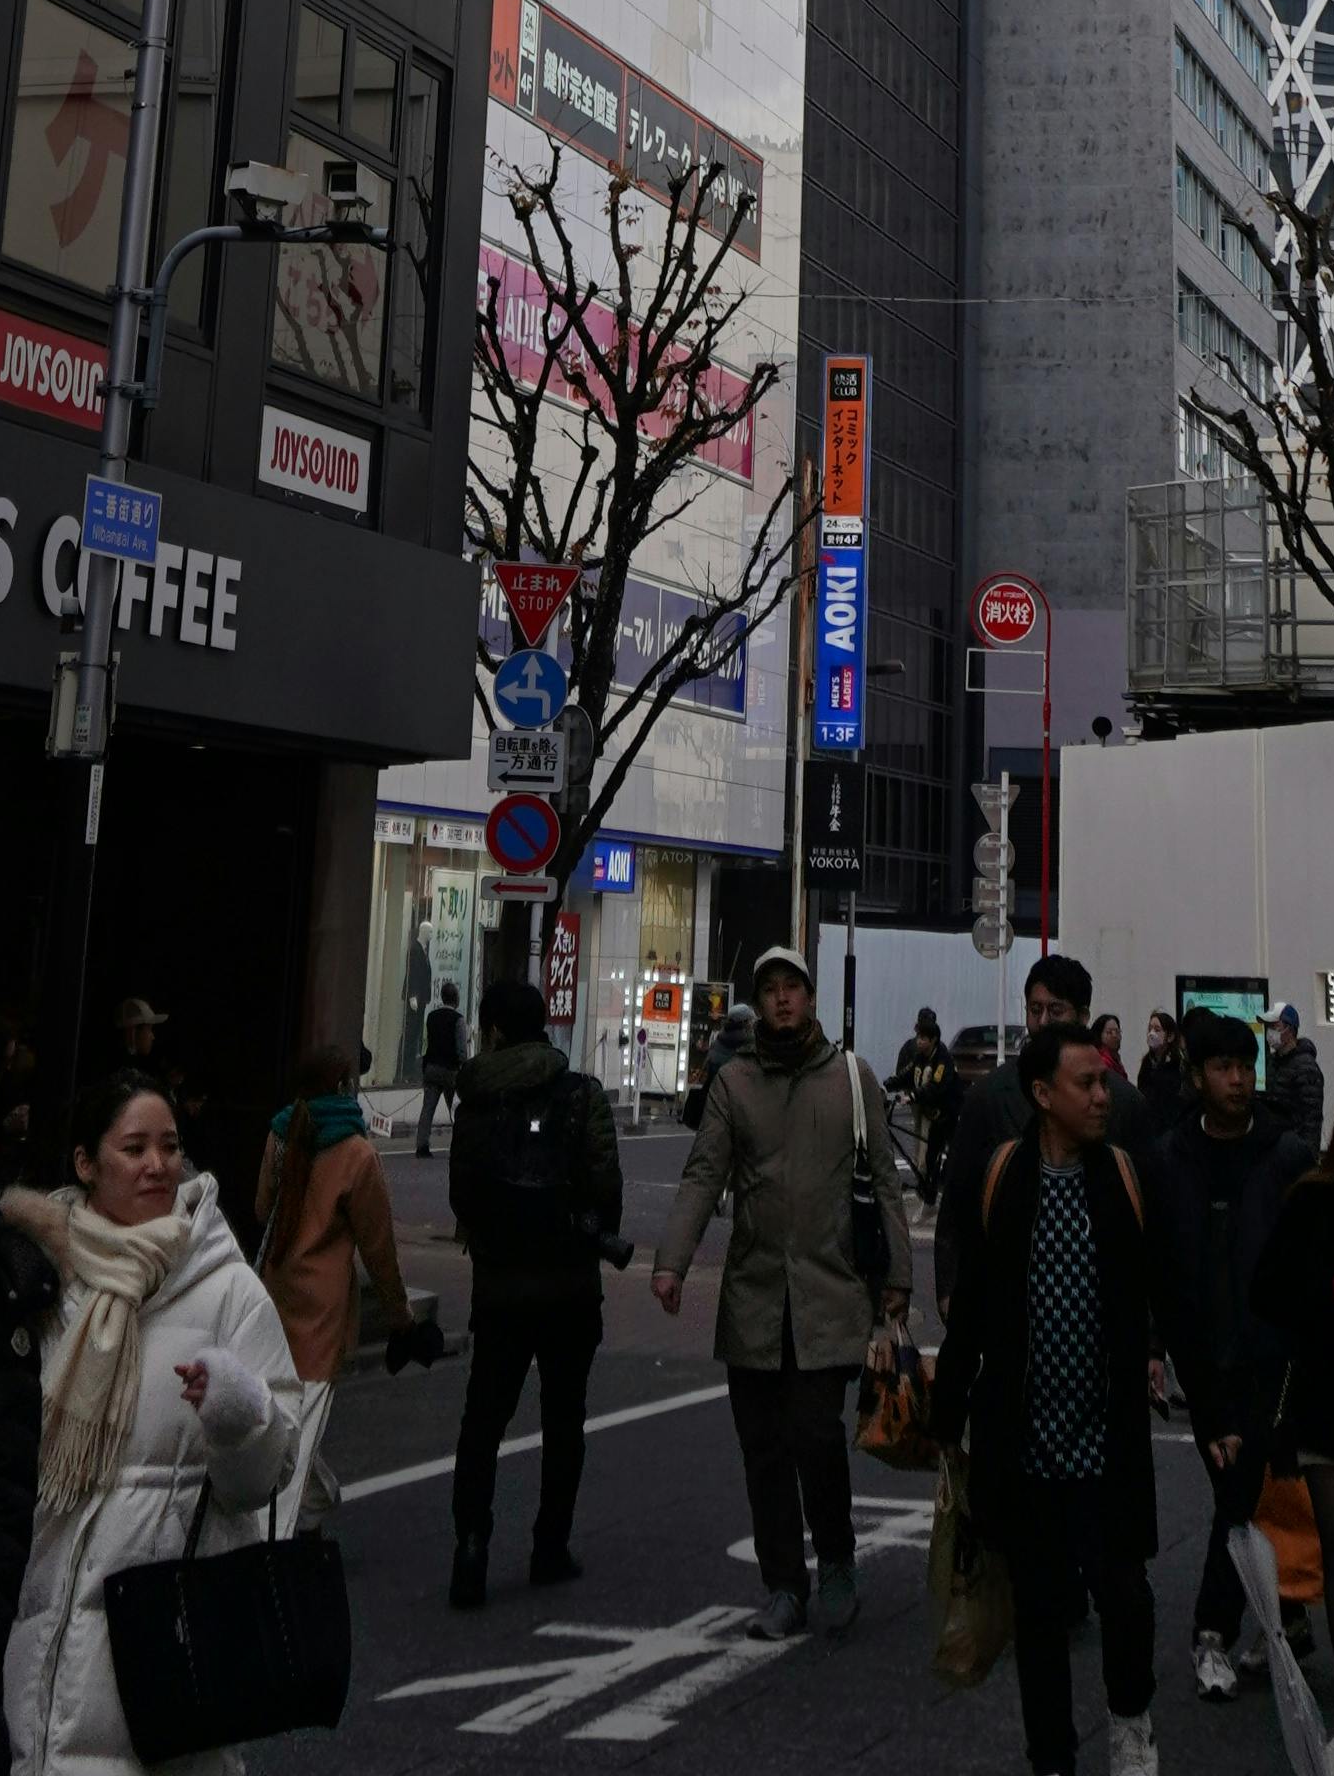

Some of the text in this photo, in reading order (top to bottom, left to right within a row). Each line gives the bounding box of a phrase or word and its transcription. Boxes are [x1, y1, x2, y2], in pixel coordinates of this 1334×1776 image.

[520, 73, 533, 96] 4F
[543, 48, 618, 135] 鍵付完全個室
[628, 107, 691, 178] テレワーク
[0, 331, 106, 413] JOYSOUN
[834, 387, 857, 397] CLUB
[846, 409, 858, 465] コミック
[269, 425, 359, 495] JOYSOUND
[832, 409, 844, 505] インターネット
[92, 490, 154, 528] 二番街通り
[40, 514, 242, 651] CFFEE
[510, 573, 562, 592] 止まれ
[518, 596, 554, 611] STOP
[824, 566, 857, 653] AOKI
[986, 600, 1031, 625] 消火栓
[495, 737, 558, 753] 自転車を除く
[821, 726, 855, 743] 1-3F
[495, 755, 558, 772] 一方通行
[607, 850, 631, 883] AOKI
[809, 856, 860, 870] YOKOTA
[553, 920, 576, 954] 大きい
[550, 954, 576, 987] サイズ
